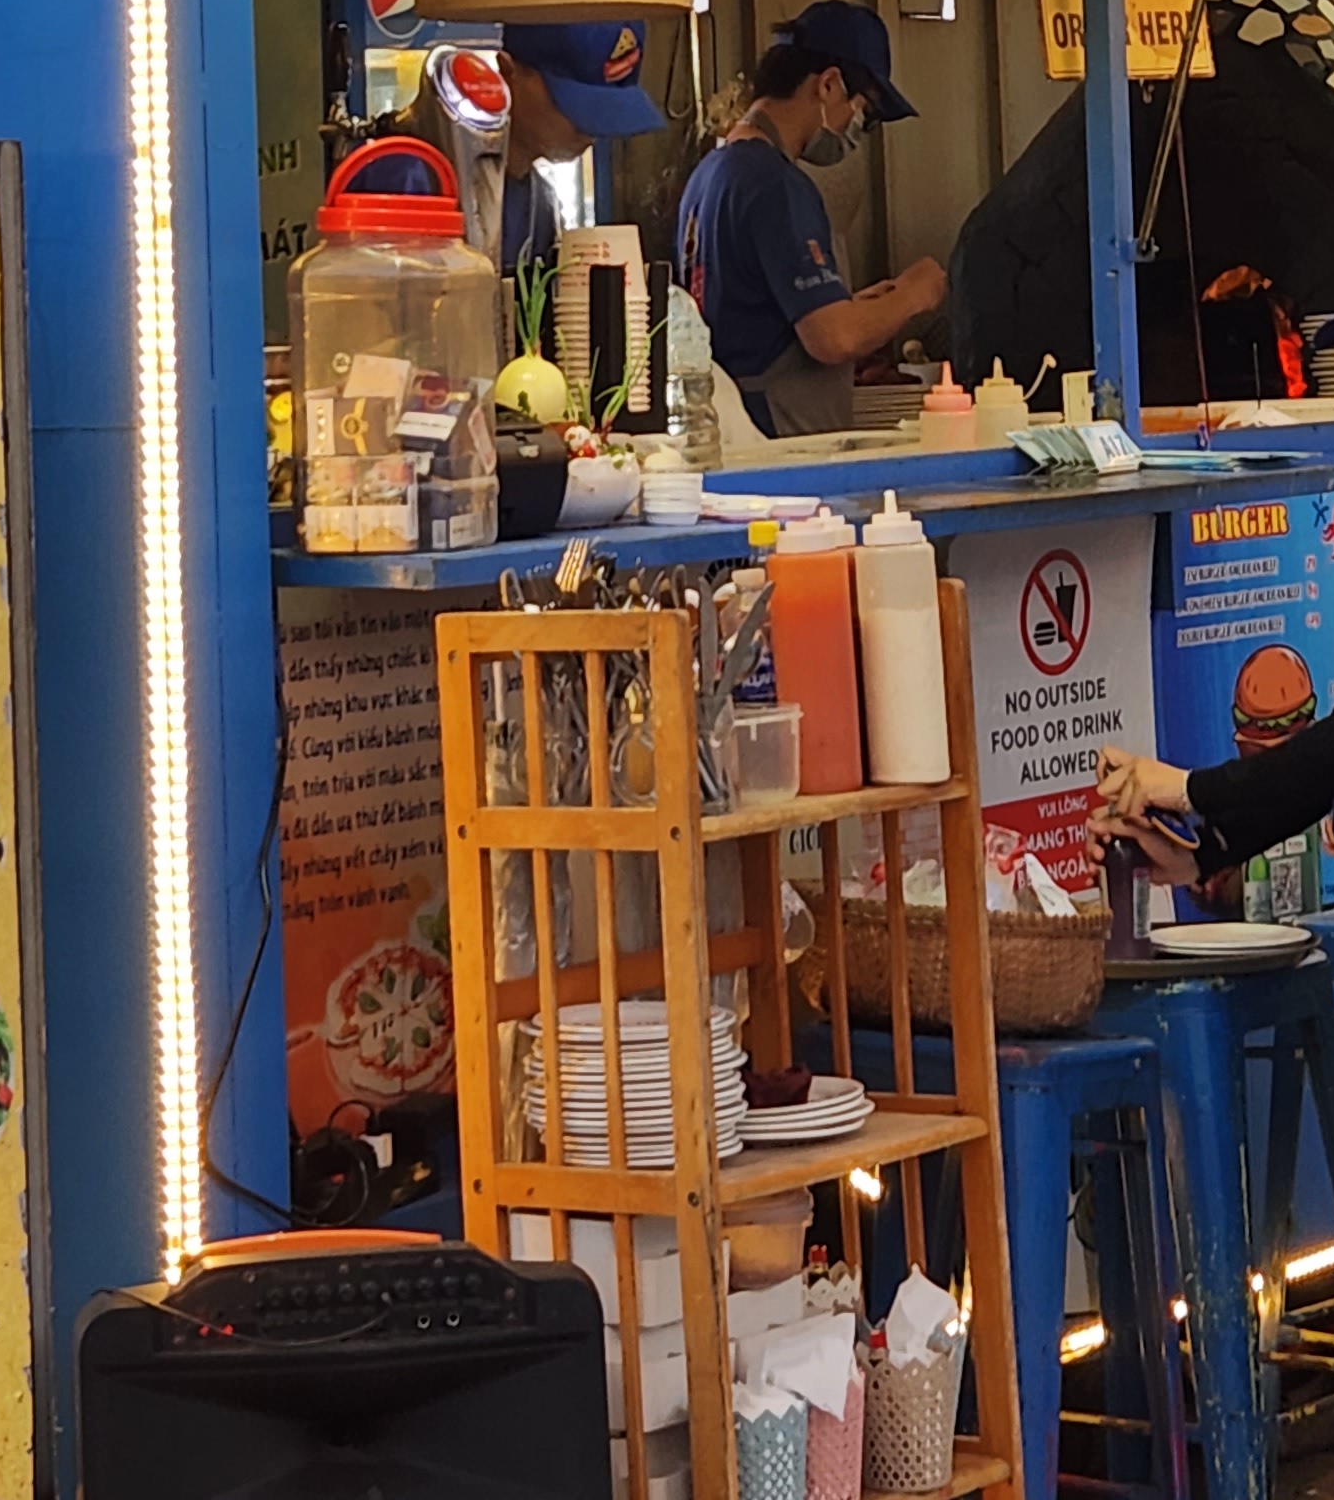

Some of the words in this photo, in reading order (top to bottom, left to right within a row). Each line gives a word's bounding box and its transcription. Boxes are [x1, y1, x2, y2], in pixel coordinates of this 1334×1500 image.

[1190, 503, 1290, 546] BURGER
[1004, 689, 1032, 716] NO
[1035, 676, 1107, 710] OUTSIDE
[990, 724, 1040, 755] FOOD
[1043, 718, 1068, 745] OR
[1072, 708, 1124, 740] DRINK
[1020, 748, 1100, 786] ALLOWED
[1037, 803, 1057, 820] VUI
[1057, 793, 1089, 817] LÒNG
